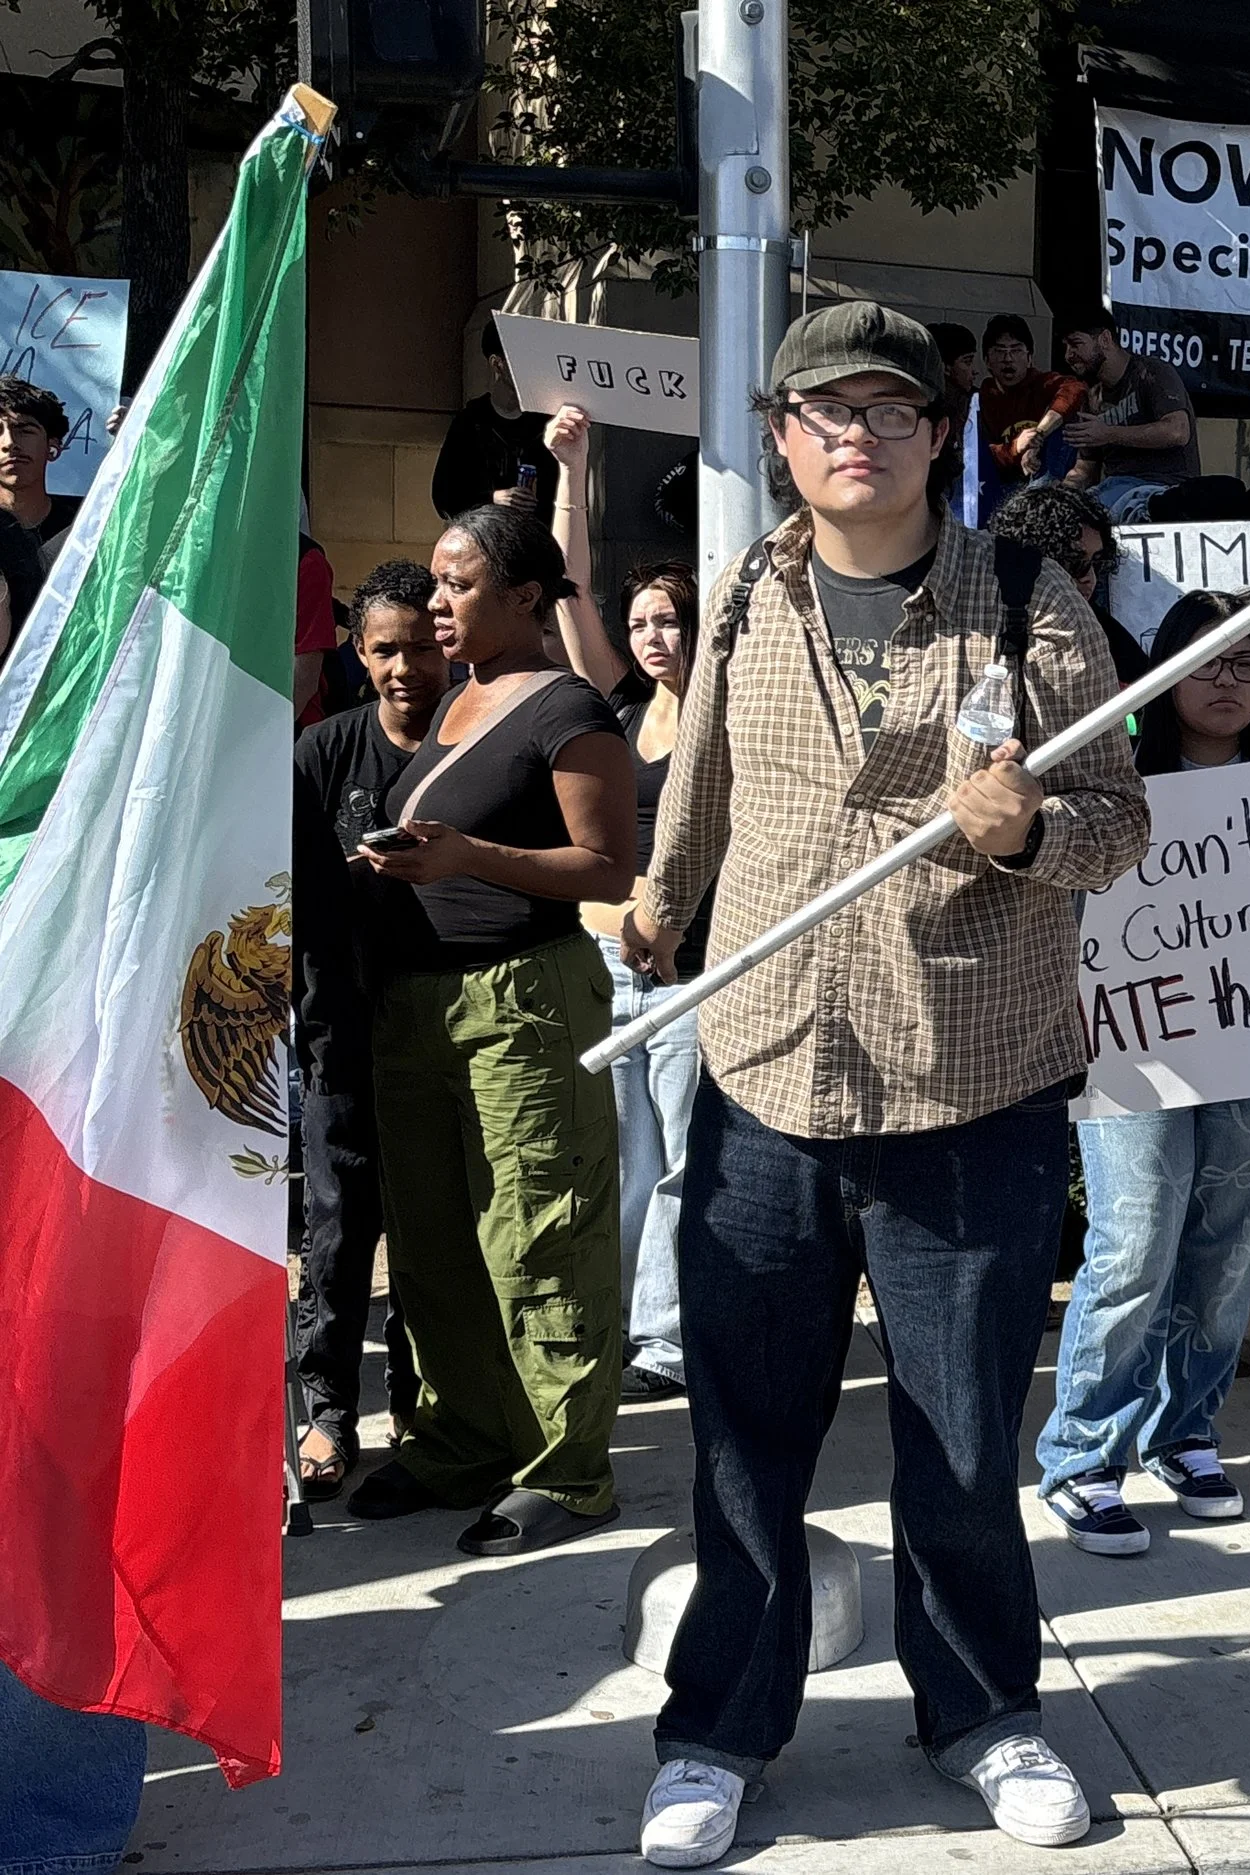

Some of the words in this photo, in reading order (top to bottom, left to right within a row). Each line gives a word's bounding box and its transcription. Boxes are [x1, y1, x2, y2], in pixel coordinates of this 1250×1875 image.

[16, 283, 108, 350] ICE
[1117, 327, 1203, 369] PRESSO
[557, 354, 687, 400] FUCK
